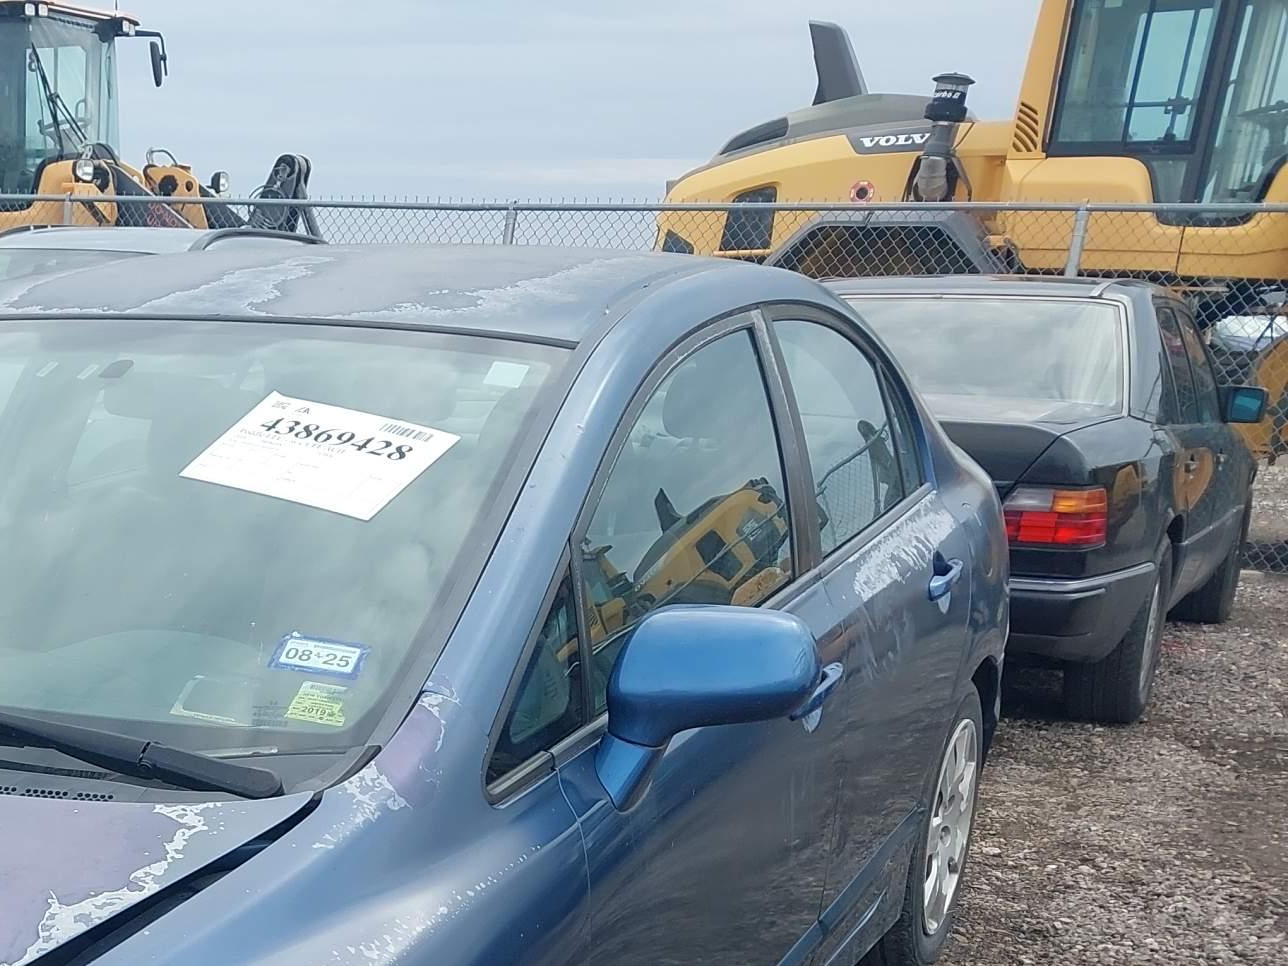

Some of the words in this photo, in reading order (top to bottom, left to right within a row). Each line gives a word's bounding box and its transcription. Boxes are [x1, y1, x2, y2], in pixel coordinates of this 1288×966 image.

[859, 132, 932, 148] VOLV
[259, 416, 415, 462] 43869428
[284, 647, 313, 662] 08
[321, 653, 353, 668] 25
[300, 705, 327, 717] 2019
